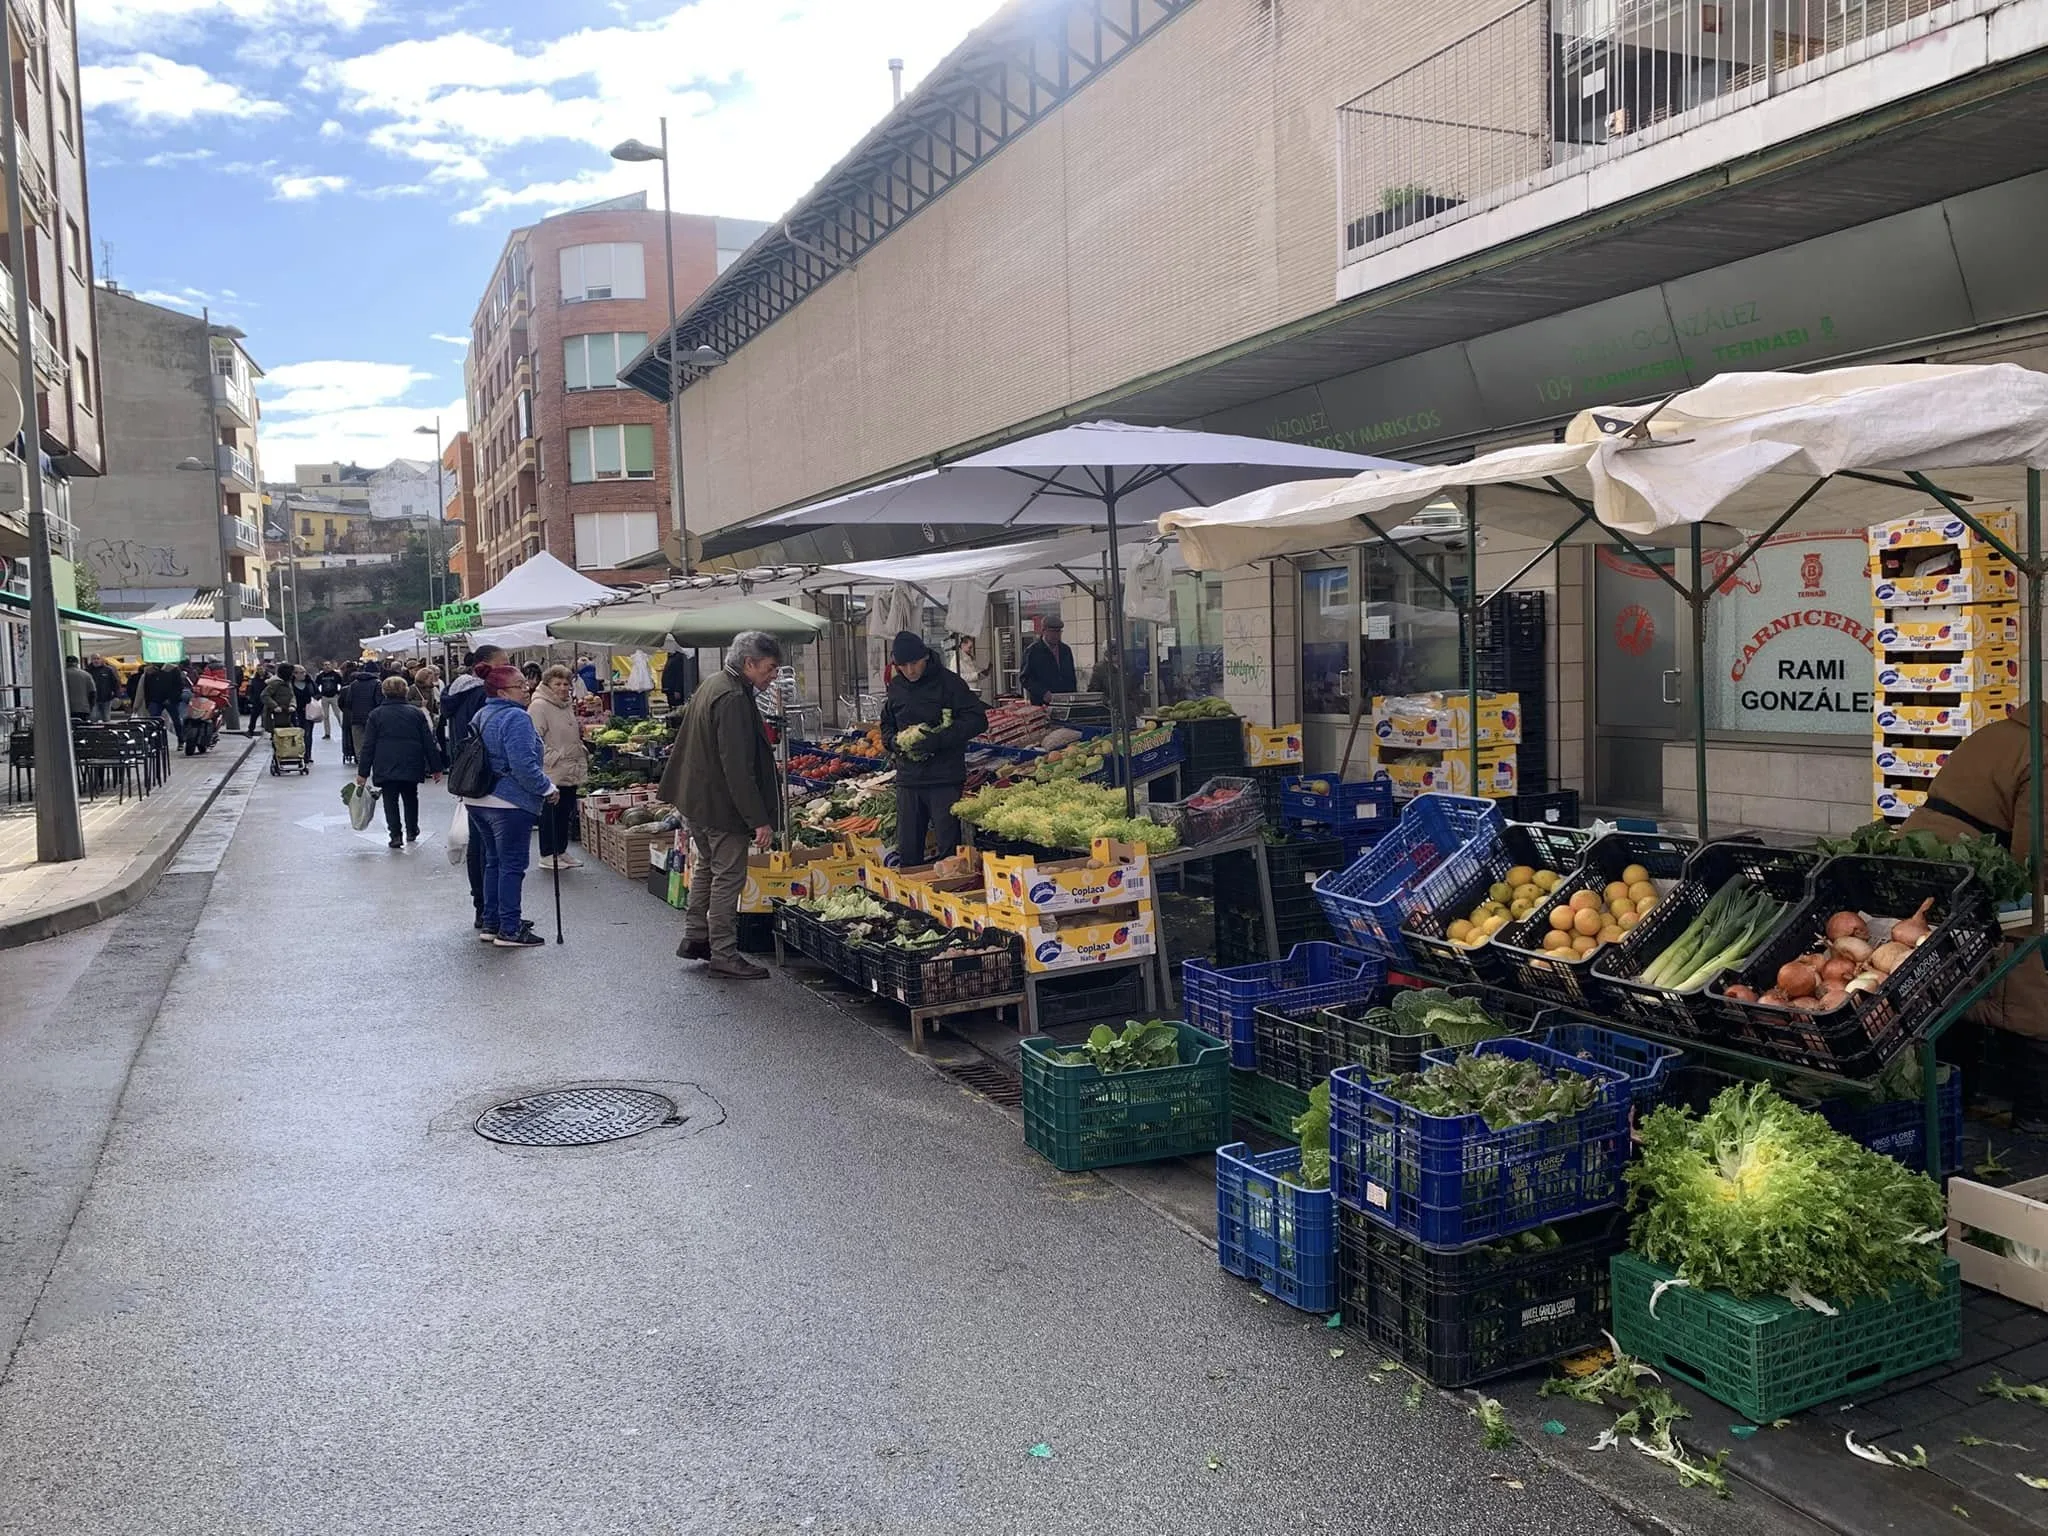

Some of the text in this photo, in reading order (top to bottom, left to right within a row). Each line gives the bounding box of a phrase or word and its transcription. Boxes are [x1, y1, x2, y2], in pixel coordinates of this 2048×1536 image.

[1632, 301, 1761, 351] GONZÁLEZ
[1535, 373, 1573, 404] 109
[1344, 431, 1356, 448] Y
[1359, 409, 1442, 446] MARISCOS
[426, 611, 443, 620] AJ
[444, 602, 480, 616] AJOS
[1778, 659, 1844, 680] RAMI
[1071, 885, 1105, 897] Coplaca
[1077, 942, 1110, 955] Coplaca
[1534, 1154, 1566, 1169] FLOREZ
